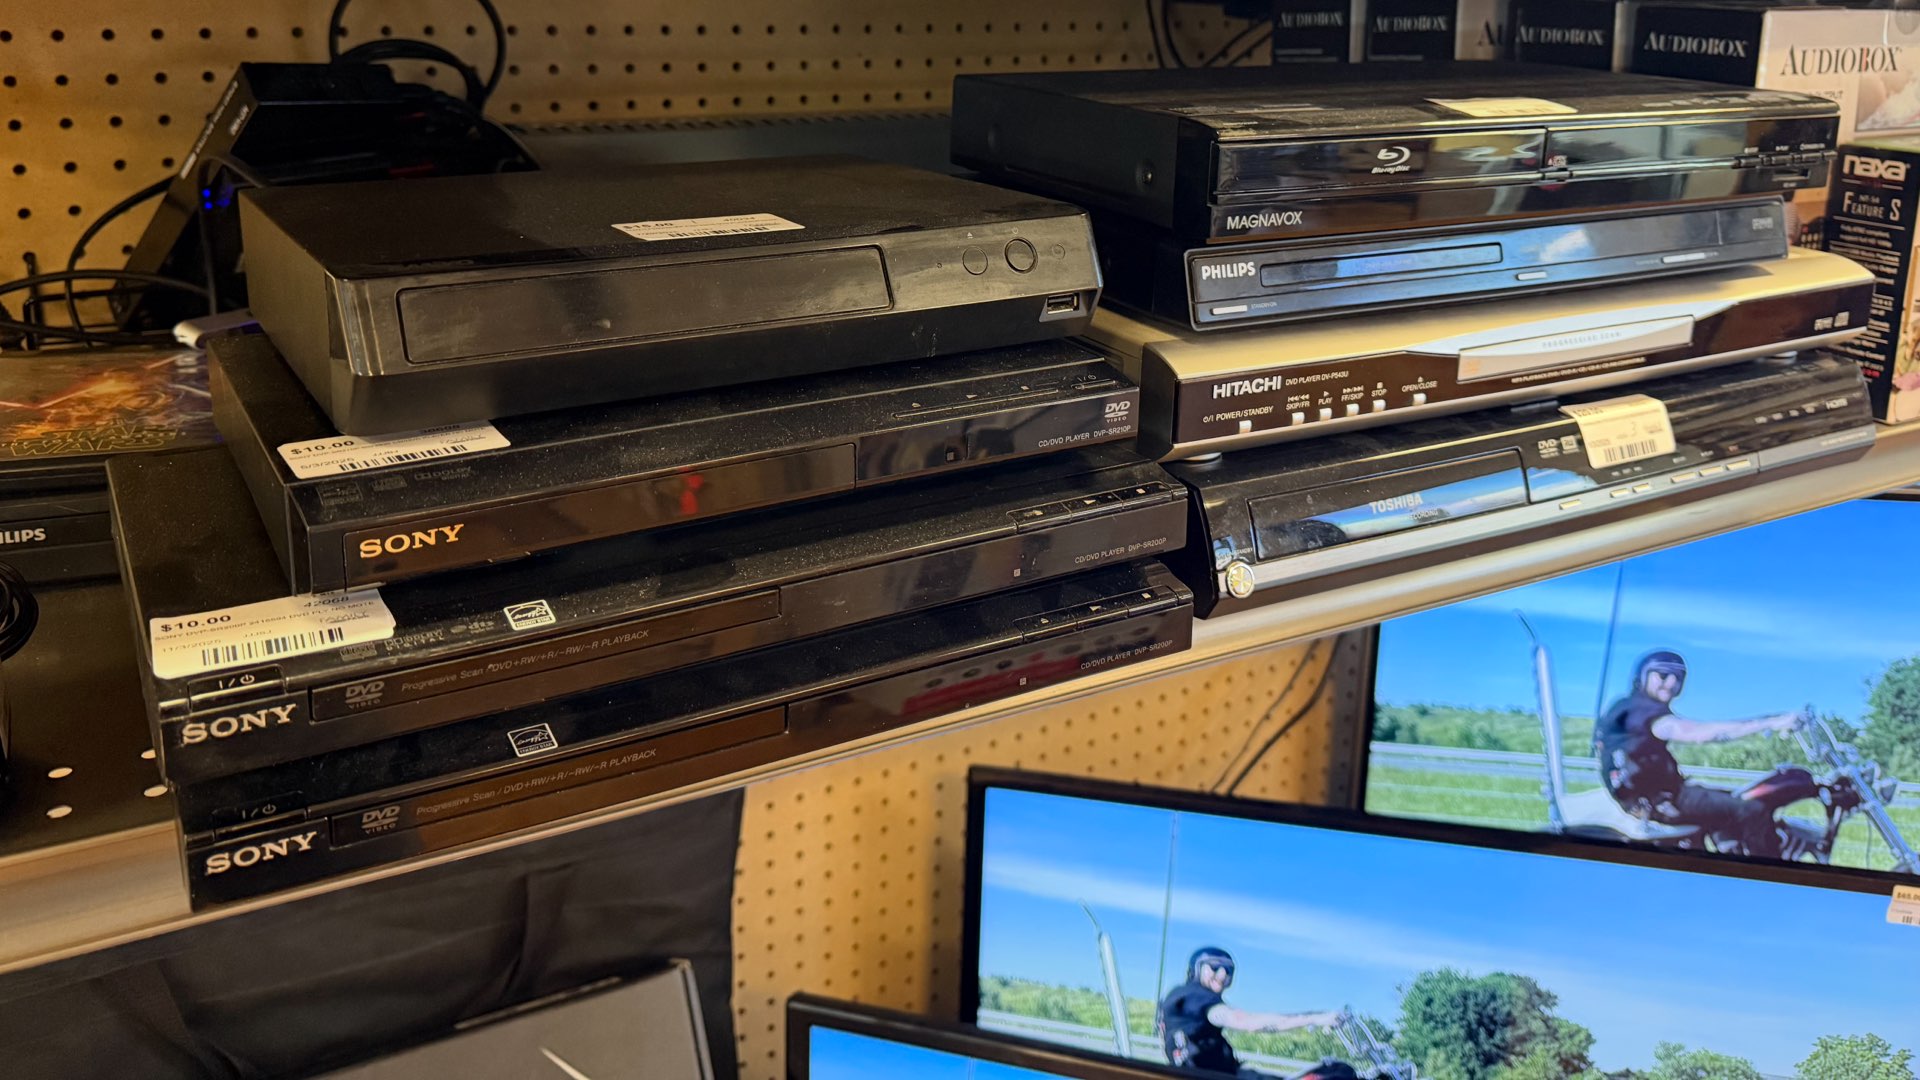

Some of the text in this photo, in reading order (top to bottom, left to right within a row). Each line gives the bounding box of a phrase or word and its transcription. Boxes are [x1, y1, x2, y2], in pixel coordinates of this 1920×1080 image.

[1517, 25, 1606, 46] AUDIOBOX
[1644, 31, 1748, 58] AUDIOBOX
[1780, 44, 1901, 76] AUDIOBOX
[1842, 155, 1907, 182] naxa
[1226, 211, 1302, 230] MAGNAVOX
[1201, 262, 1256, 280] PHILIPS
[1213, 375, 1282, 399] HITACHI
[1286, 378, 1298, 386] DVD
[1298, 375, 1321, 384] PLAYER
[1401, 380, 1438, 392] OPEN/CLOSE
[1318, 397, 1333, 405] PLAY
[1341, 392, 1364, 402] FF/SKIP
[1371, 389, 1388, 397] STOP
[1105, 400, 1131, 413] DVD
[1216, 406, 1274, 422] POWER/STANDBY
[1286, 401, 1310, 411] SKIP/FR
[1106, 415, 1128, 424] VIDEO
[1038, 425, 1131, 448] CD/DVD PLAYER DVP-SR210P
[290, 440, 355, 455] $10.00
[1369, 492, 1424, 514] TOSHIBA
[359, 523, 465, 558] SONY
[1074, 537, 1167, 564] CD/DVD PLAYER DVP-SR200P
[160, 615, 231, 632] $10.00
[401, 672, 457, 691] Progressive
[460, 667, 484, 679] Scan
[600, 629, 650, 647] PLAYBACK
[1080, 640, 1173, 670] CD/DVD PLAYER DVP-SR200P
[345, 681, 385, 698] DVD
[348, 699, 381, 710] VIDEO
[182, 703, 297, 745] SONY
[417, 797, 470, 815] Progressive
[472, 790, 496, 801] Scan
[608, 748, 657, 767] PLAYBACK
[362, 805, 400, 823] DVD
[365, 823, 397, 834] VIDEO
[206, 831, 318, 875] SONY
